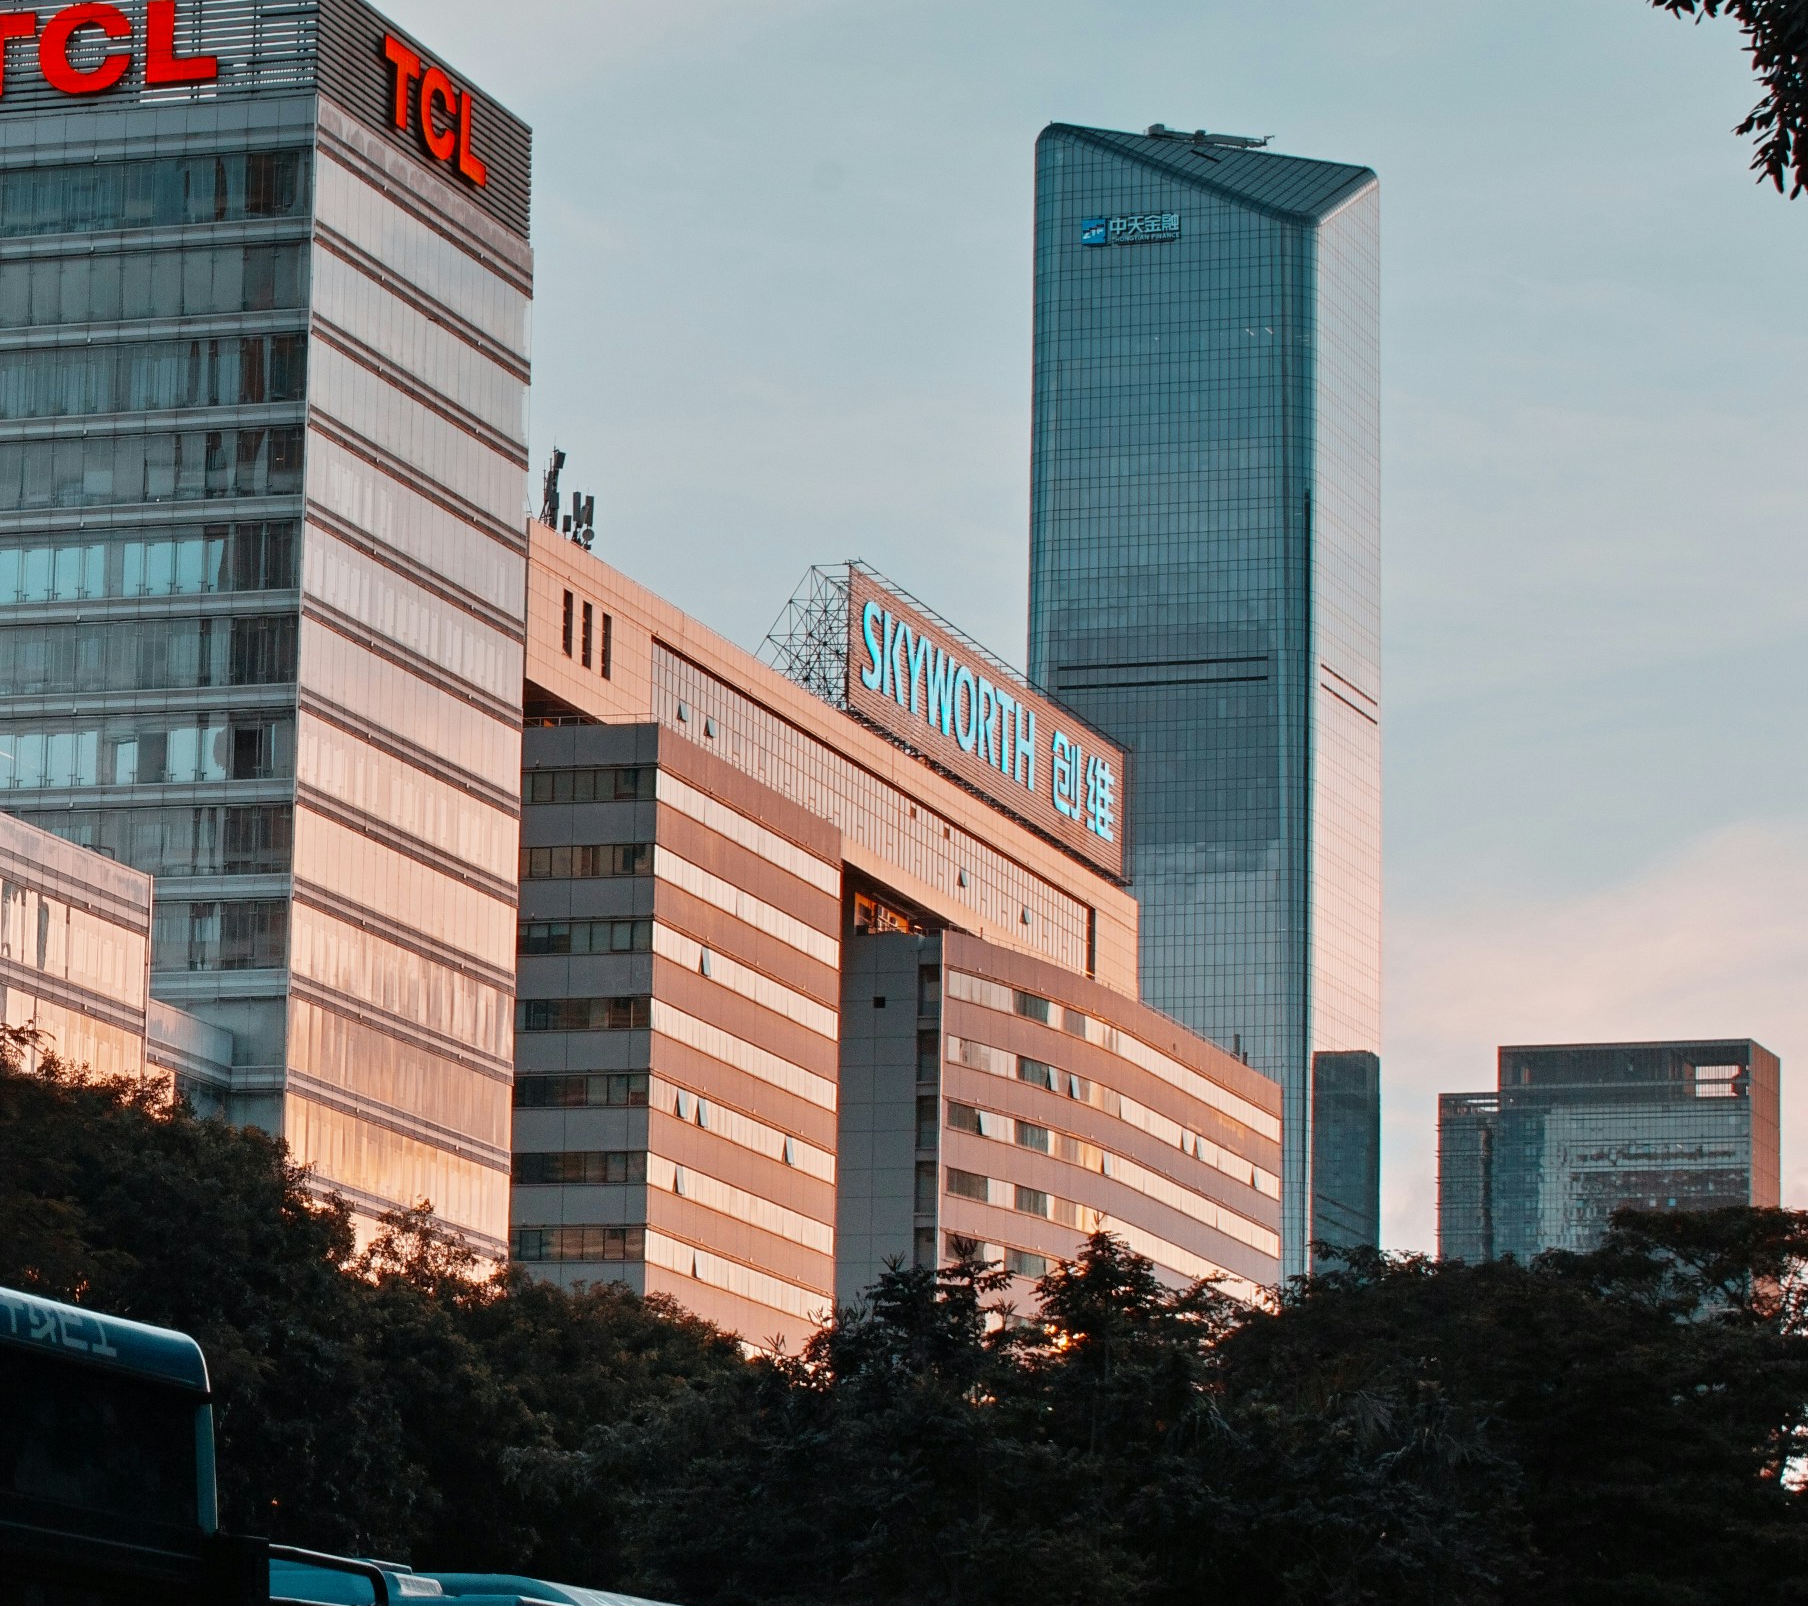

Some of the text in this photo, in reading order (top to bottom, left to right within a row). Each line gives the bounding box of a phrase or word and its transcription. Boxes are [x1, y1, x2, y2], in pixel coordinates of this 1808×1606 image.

[383, 33, 488, 188] TCL
[1109, 213, 1180, 236] 中天金融
[861, 601, 1114, 842] SKYWORTH 创维
